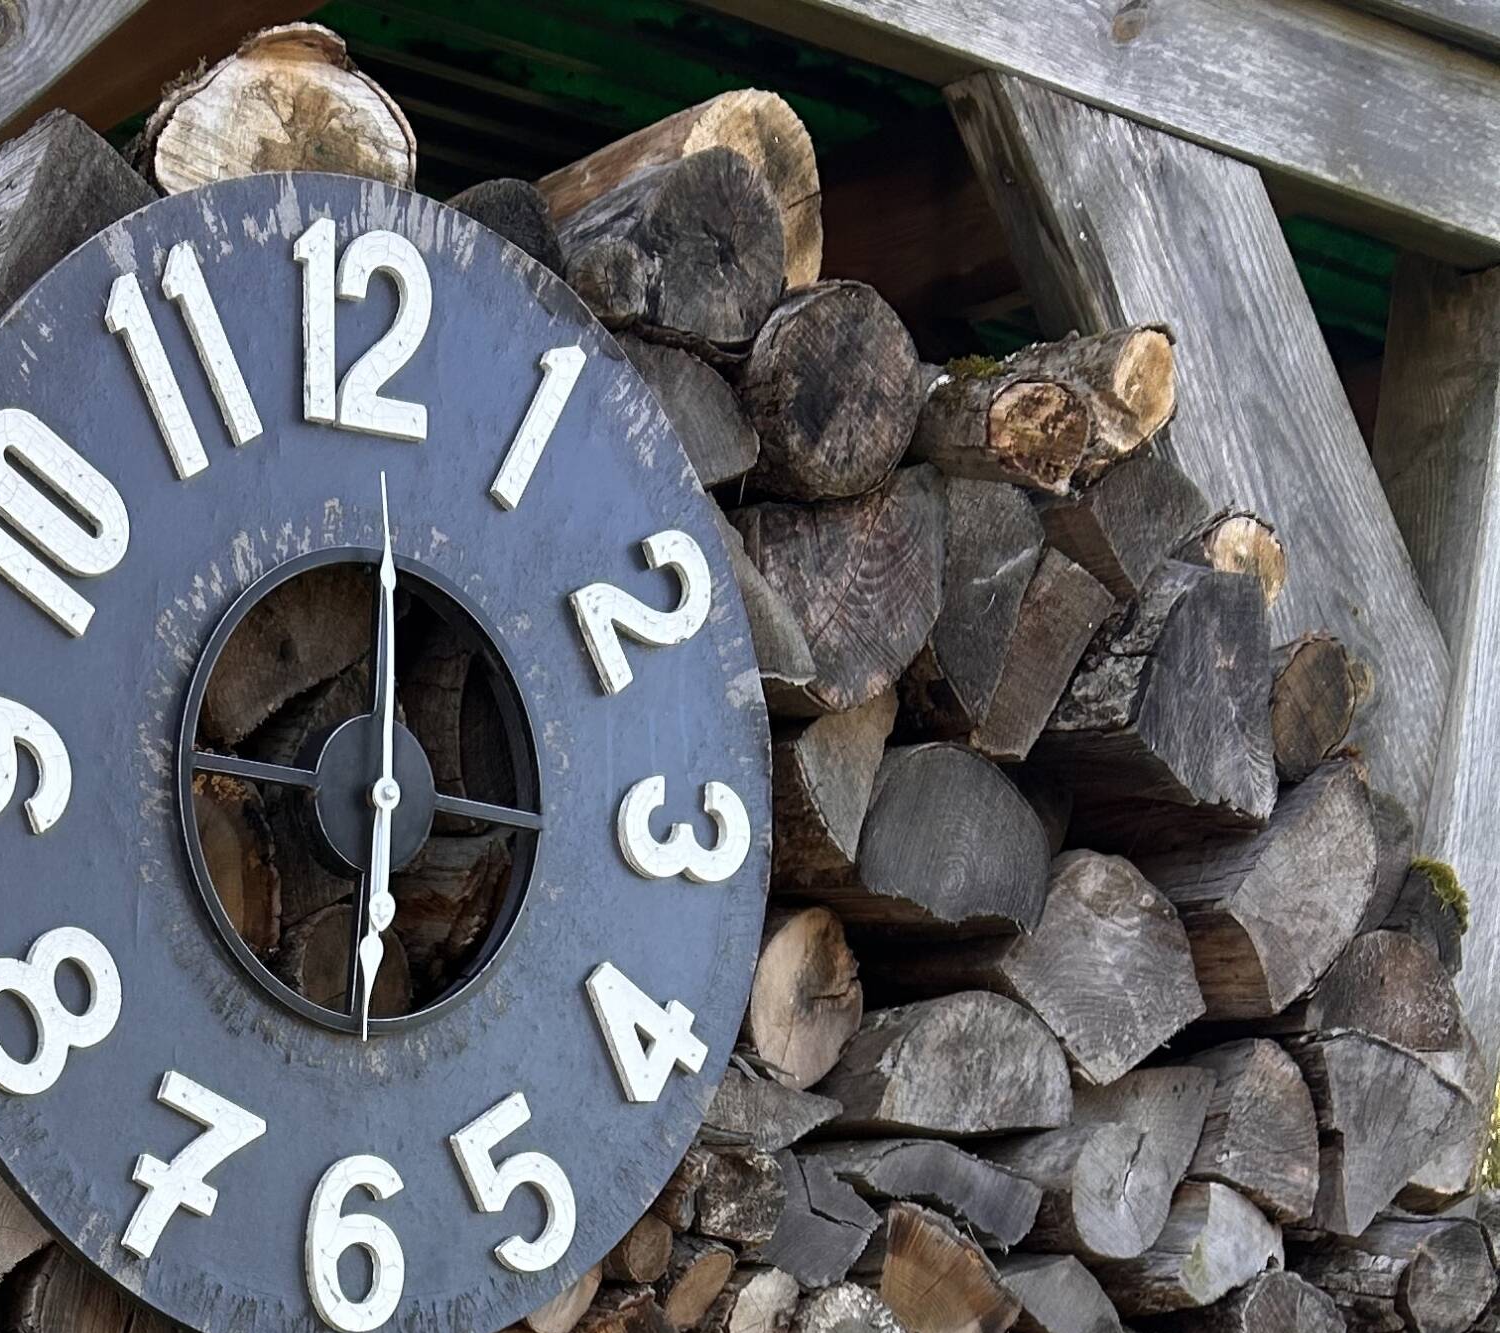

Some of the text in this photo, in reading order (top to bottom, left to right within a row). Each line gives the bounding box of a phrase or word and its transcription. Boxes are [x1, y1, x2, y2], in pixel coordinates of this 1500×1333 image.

[104, 241, 263, 481] 11
[293, 216, 429, 442] 12
[489, 345, 586, 510] 1
[569, 530, 712, 696] 2
[618, 776, 751, 882] 3
[586, 962, 709, 1102] 4
[122, 1070, 267, 1258] 7
[304, 1154, 405, 1333] 6
[450, 1091, 576, 1274] 5
